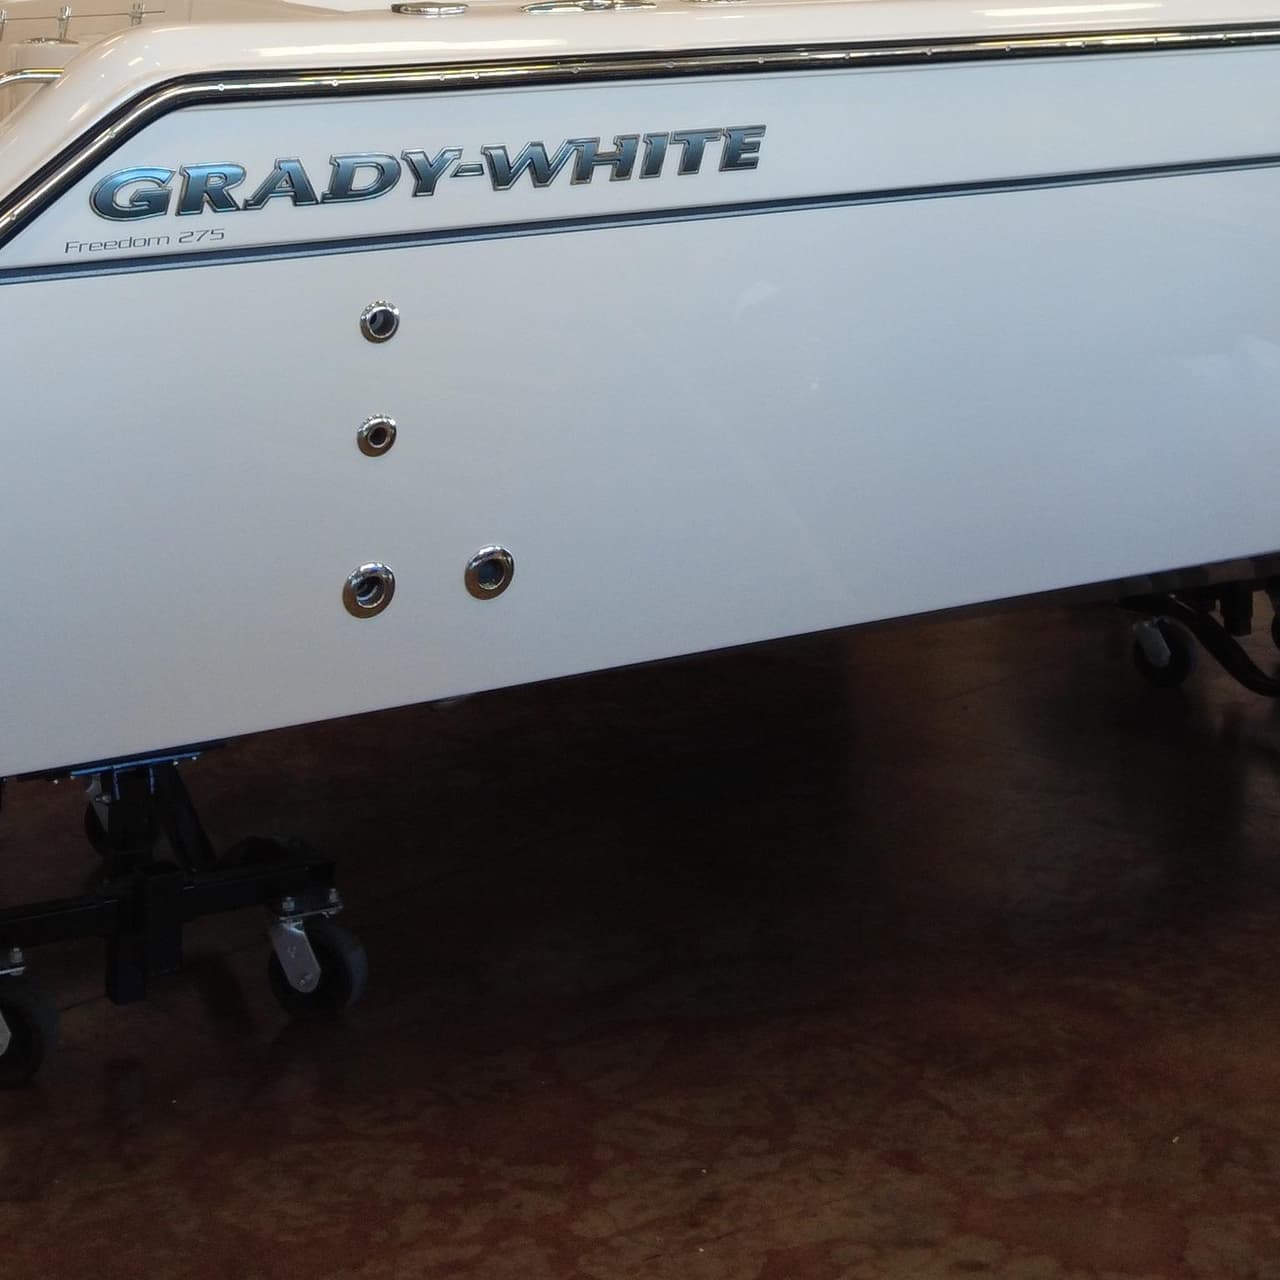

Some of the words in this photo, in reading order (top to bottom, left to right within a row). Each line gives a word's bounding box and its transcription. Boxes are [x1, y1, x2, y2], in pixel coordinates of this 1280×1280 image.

[89, 124, 766, 222] GRADY-WHITE
[64, 232, 170, 254] Freedom
[178, 227, 225, 245] 275
